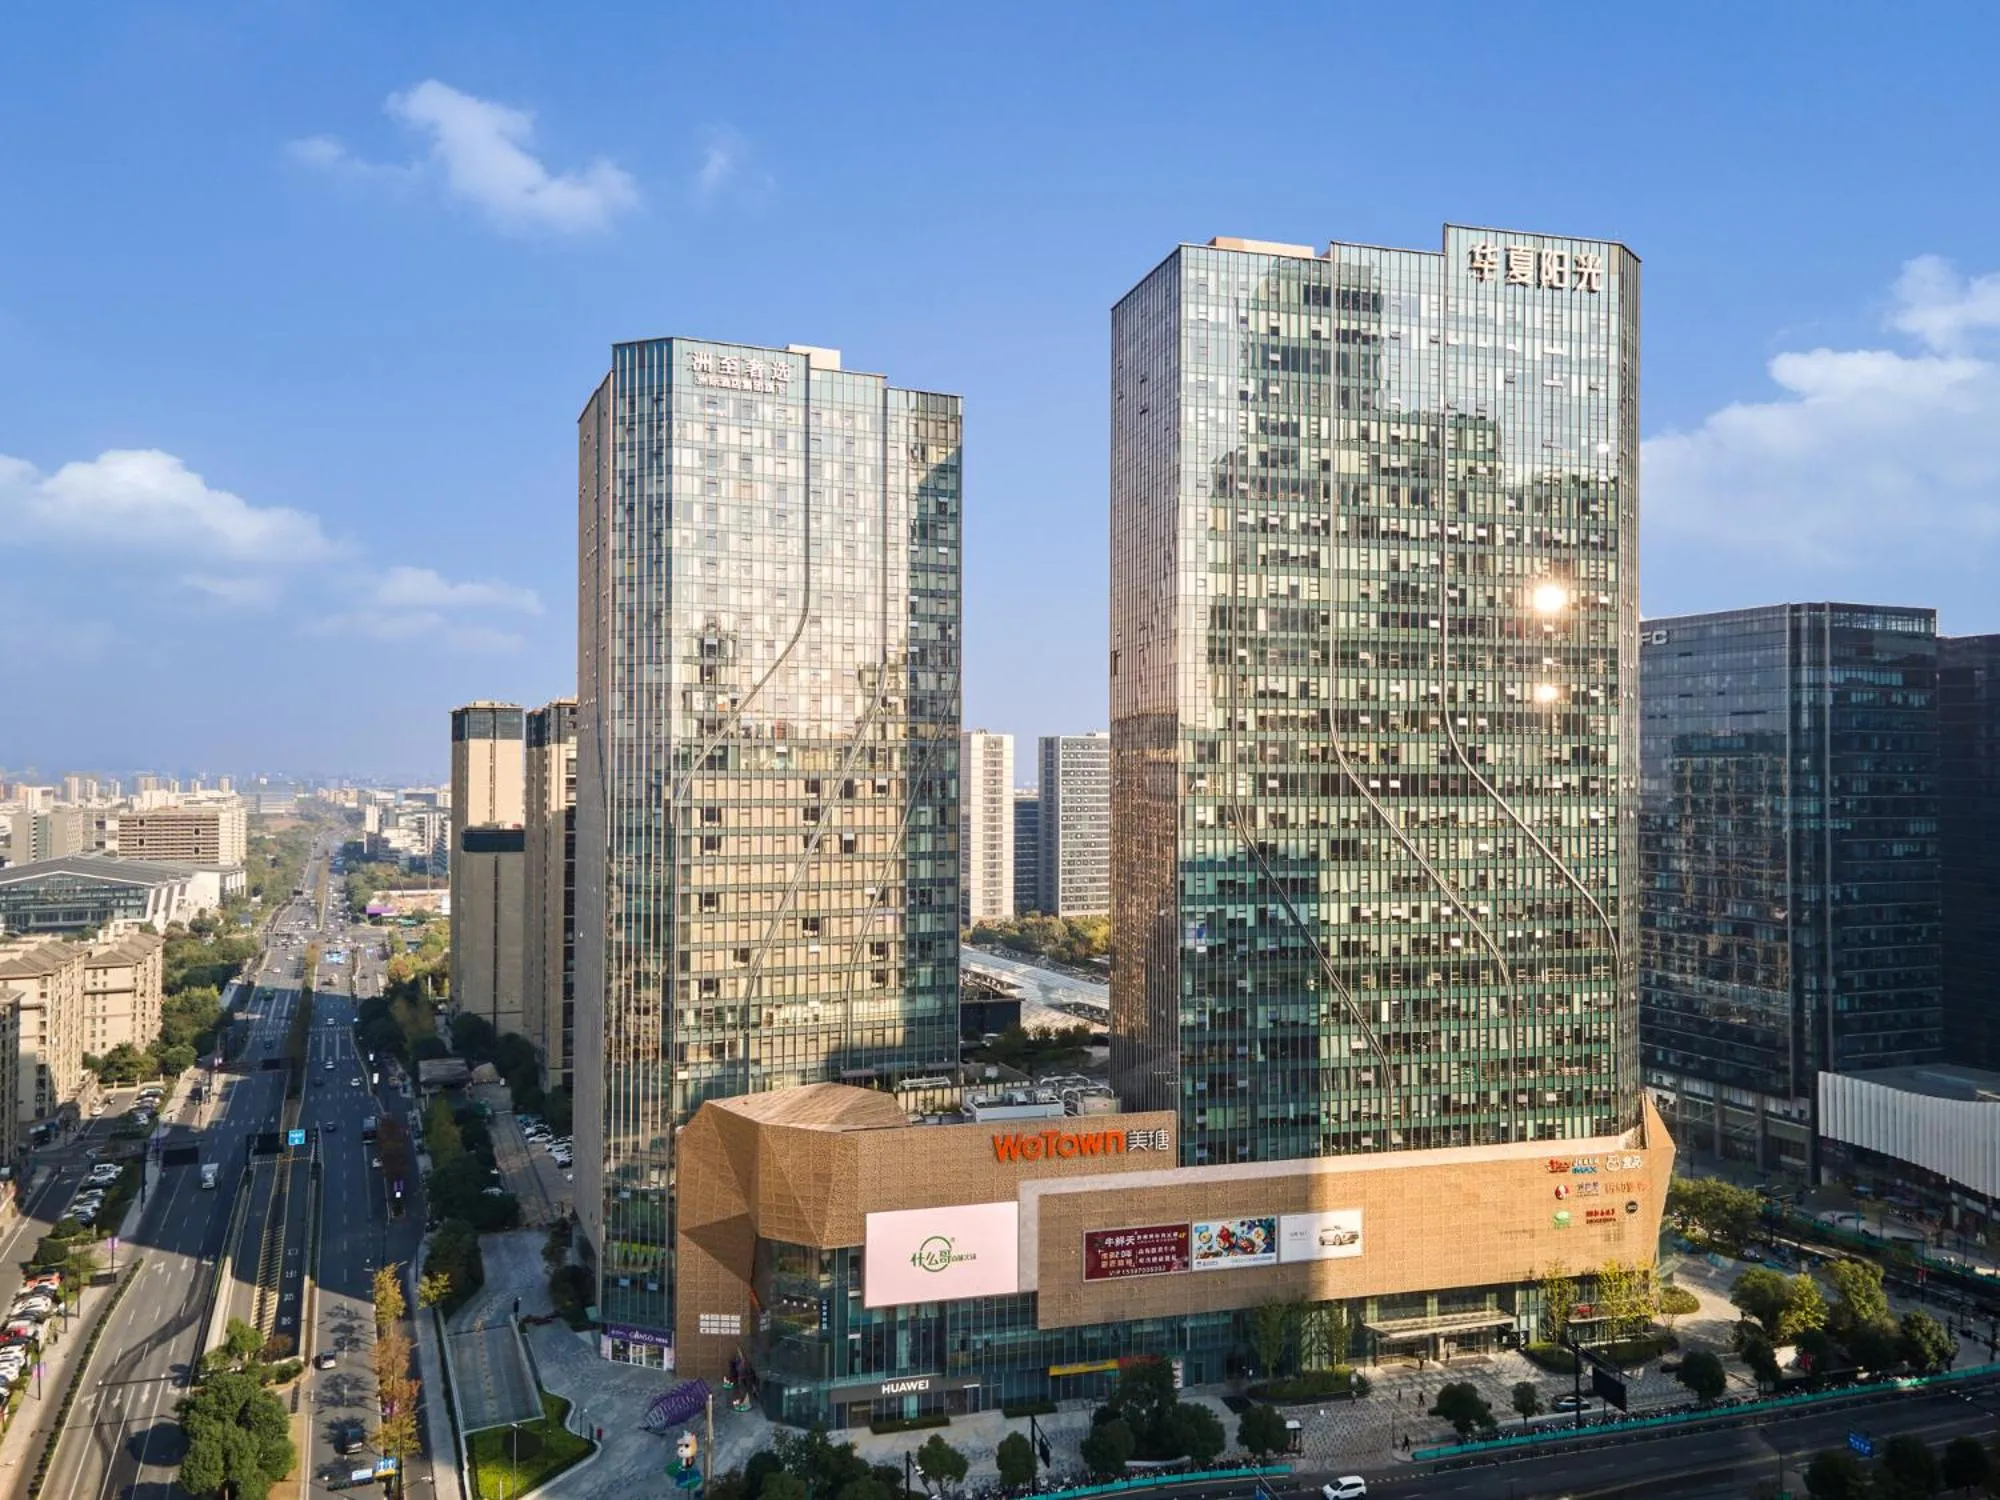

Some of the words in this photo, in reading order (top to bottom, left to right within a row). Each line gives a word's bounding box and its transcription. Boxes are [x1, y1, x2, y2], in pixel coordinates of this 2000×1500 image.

[1469, 243, 1604, 292] 华夏阳光
[993, 1129, 1125, 1162] WeTown
[881, 1379, 929, 1395] HUAWEI
